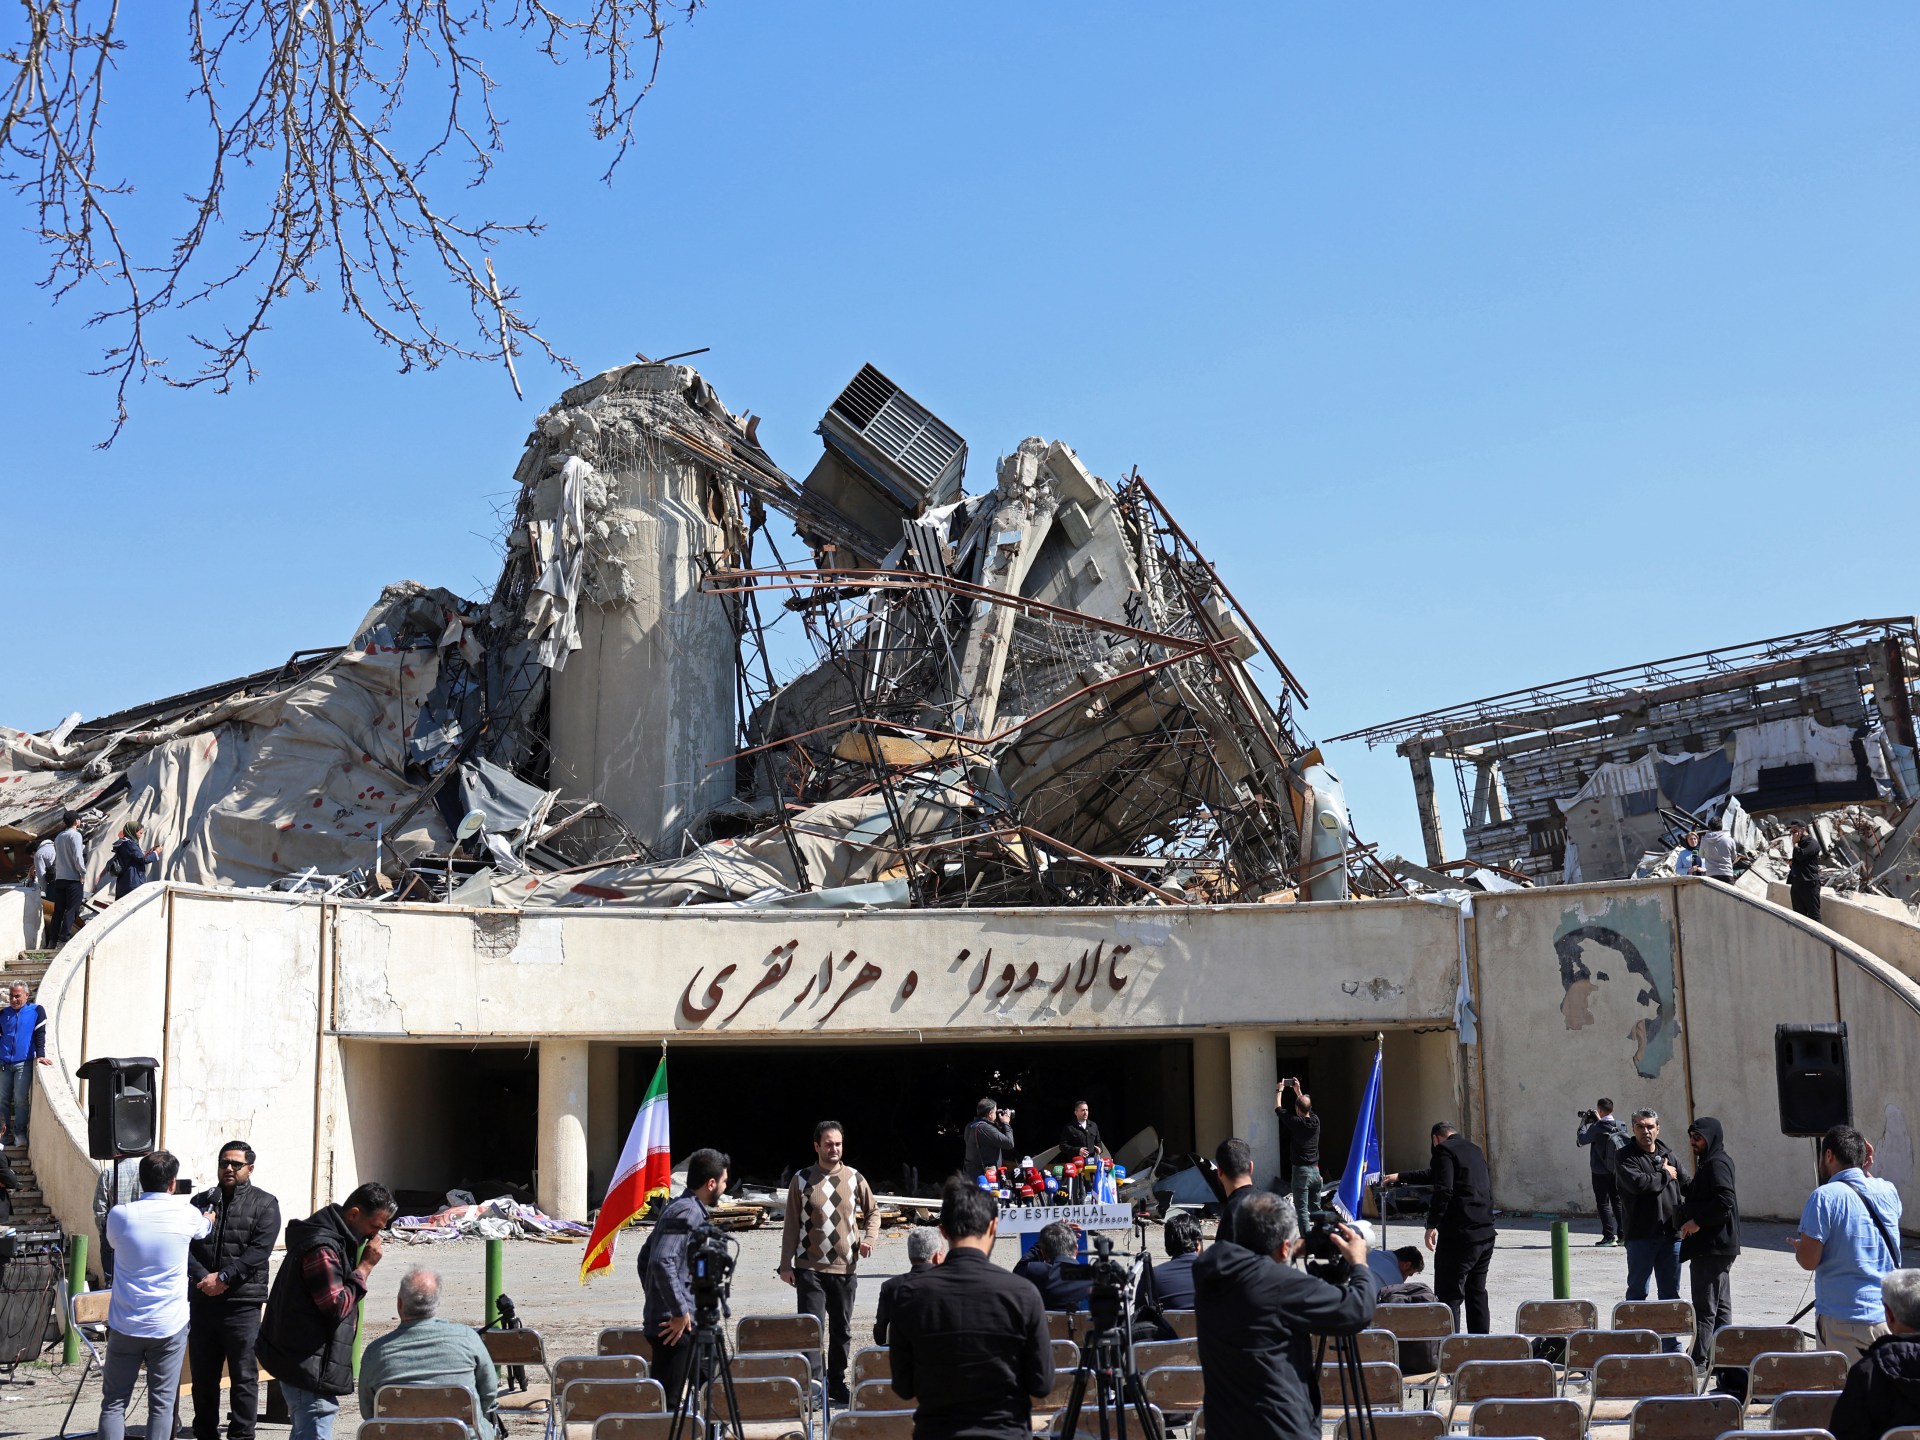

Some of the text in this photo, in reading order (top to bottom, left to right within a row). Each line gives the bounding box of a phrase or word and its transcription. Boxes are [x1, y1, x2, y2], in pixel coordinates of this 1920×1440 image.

[682, 938, 799, 1023] نفری
[794, 949, 882, 1023] هزار
[1051, 939, 1131, 994] تالار
[1001, 1206, 1108, 1220] FC ESTEGHLAL
[1064, 1216, 1129, 1225] POKESPERSON
